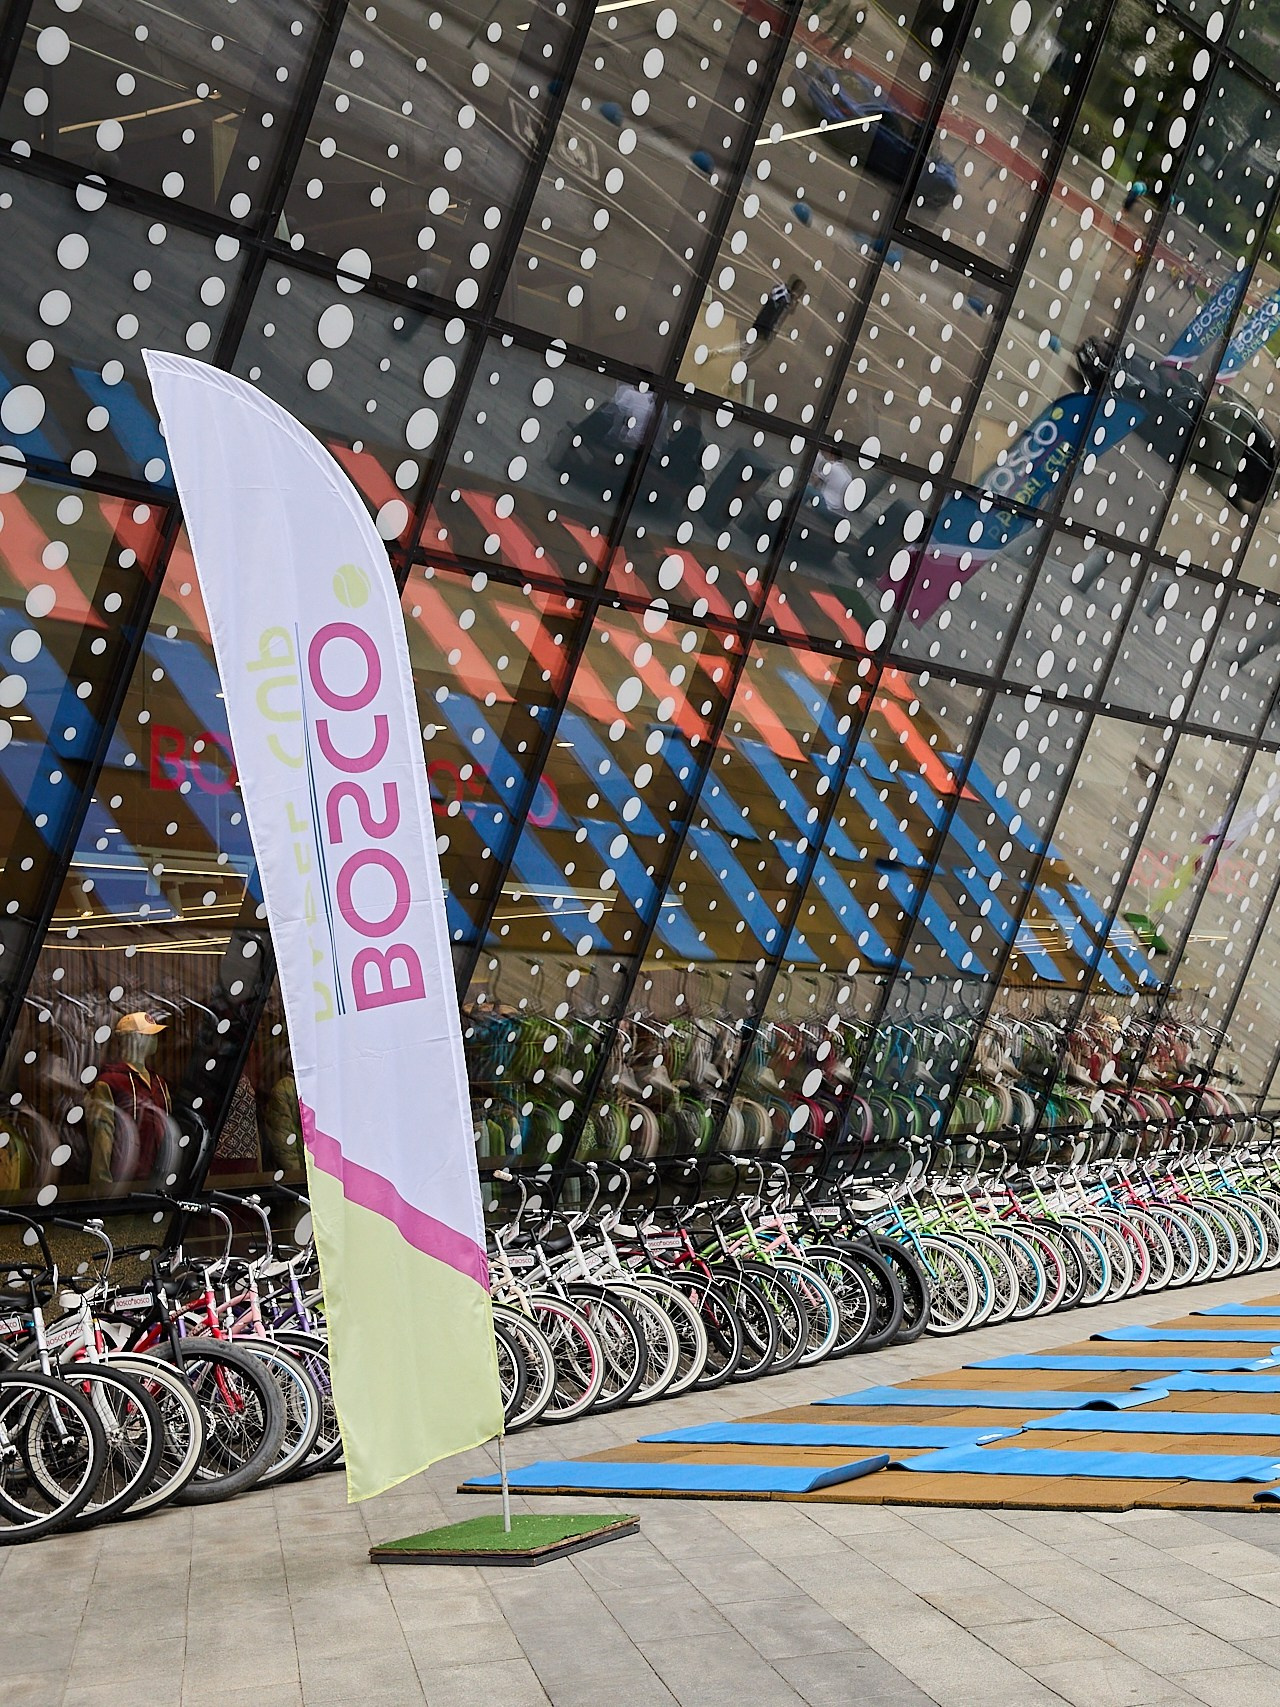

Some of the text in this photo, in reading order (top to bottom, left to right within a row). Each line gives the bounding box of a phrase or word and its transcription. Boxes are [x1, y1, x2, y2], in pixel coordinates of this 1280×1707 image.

[1192, 287, 1236, 338] BOSCO
[982, 420, 1058, 495] OSCO
[116, 1297, 150, 1308] BOSCO BOSCO
[46, 1324, 84, 1347] BOSCO BOSC
